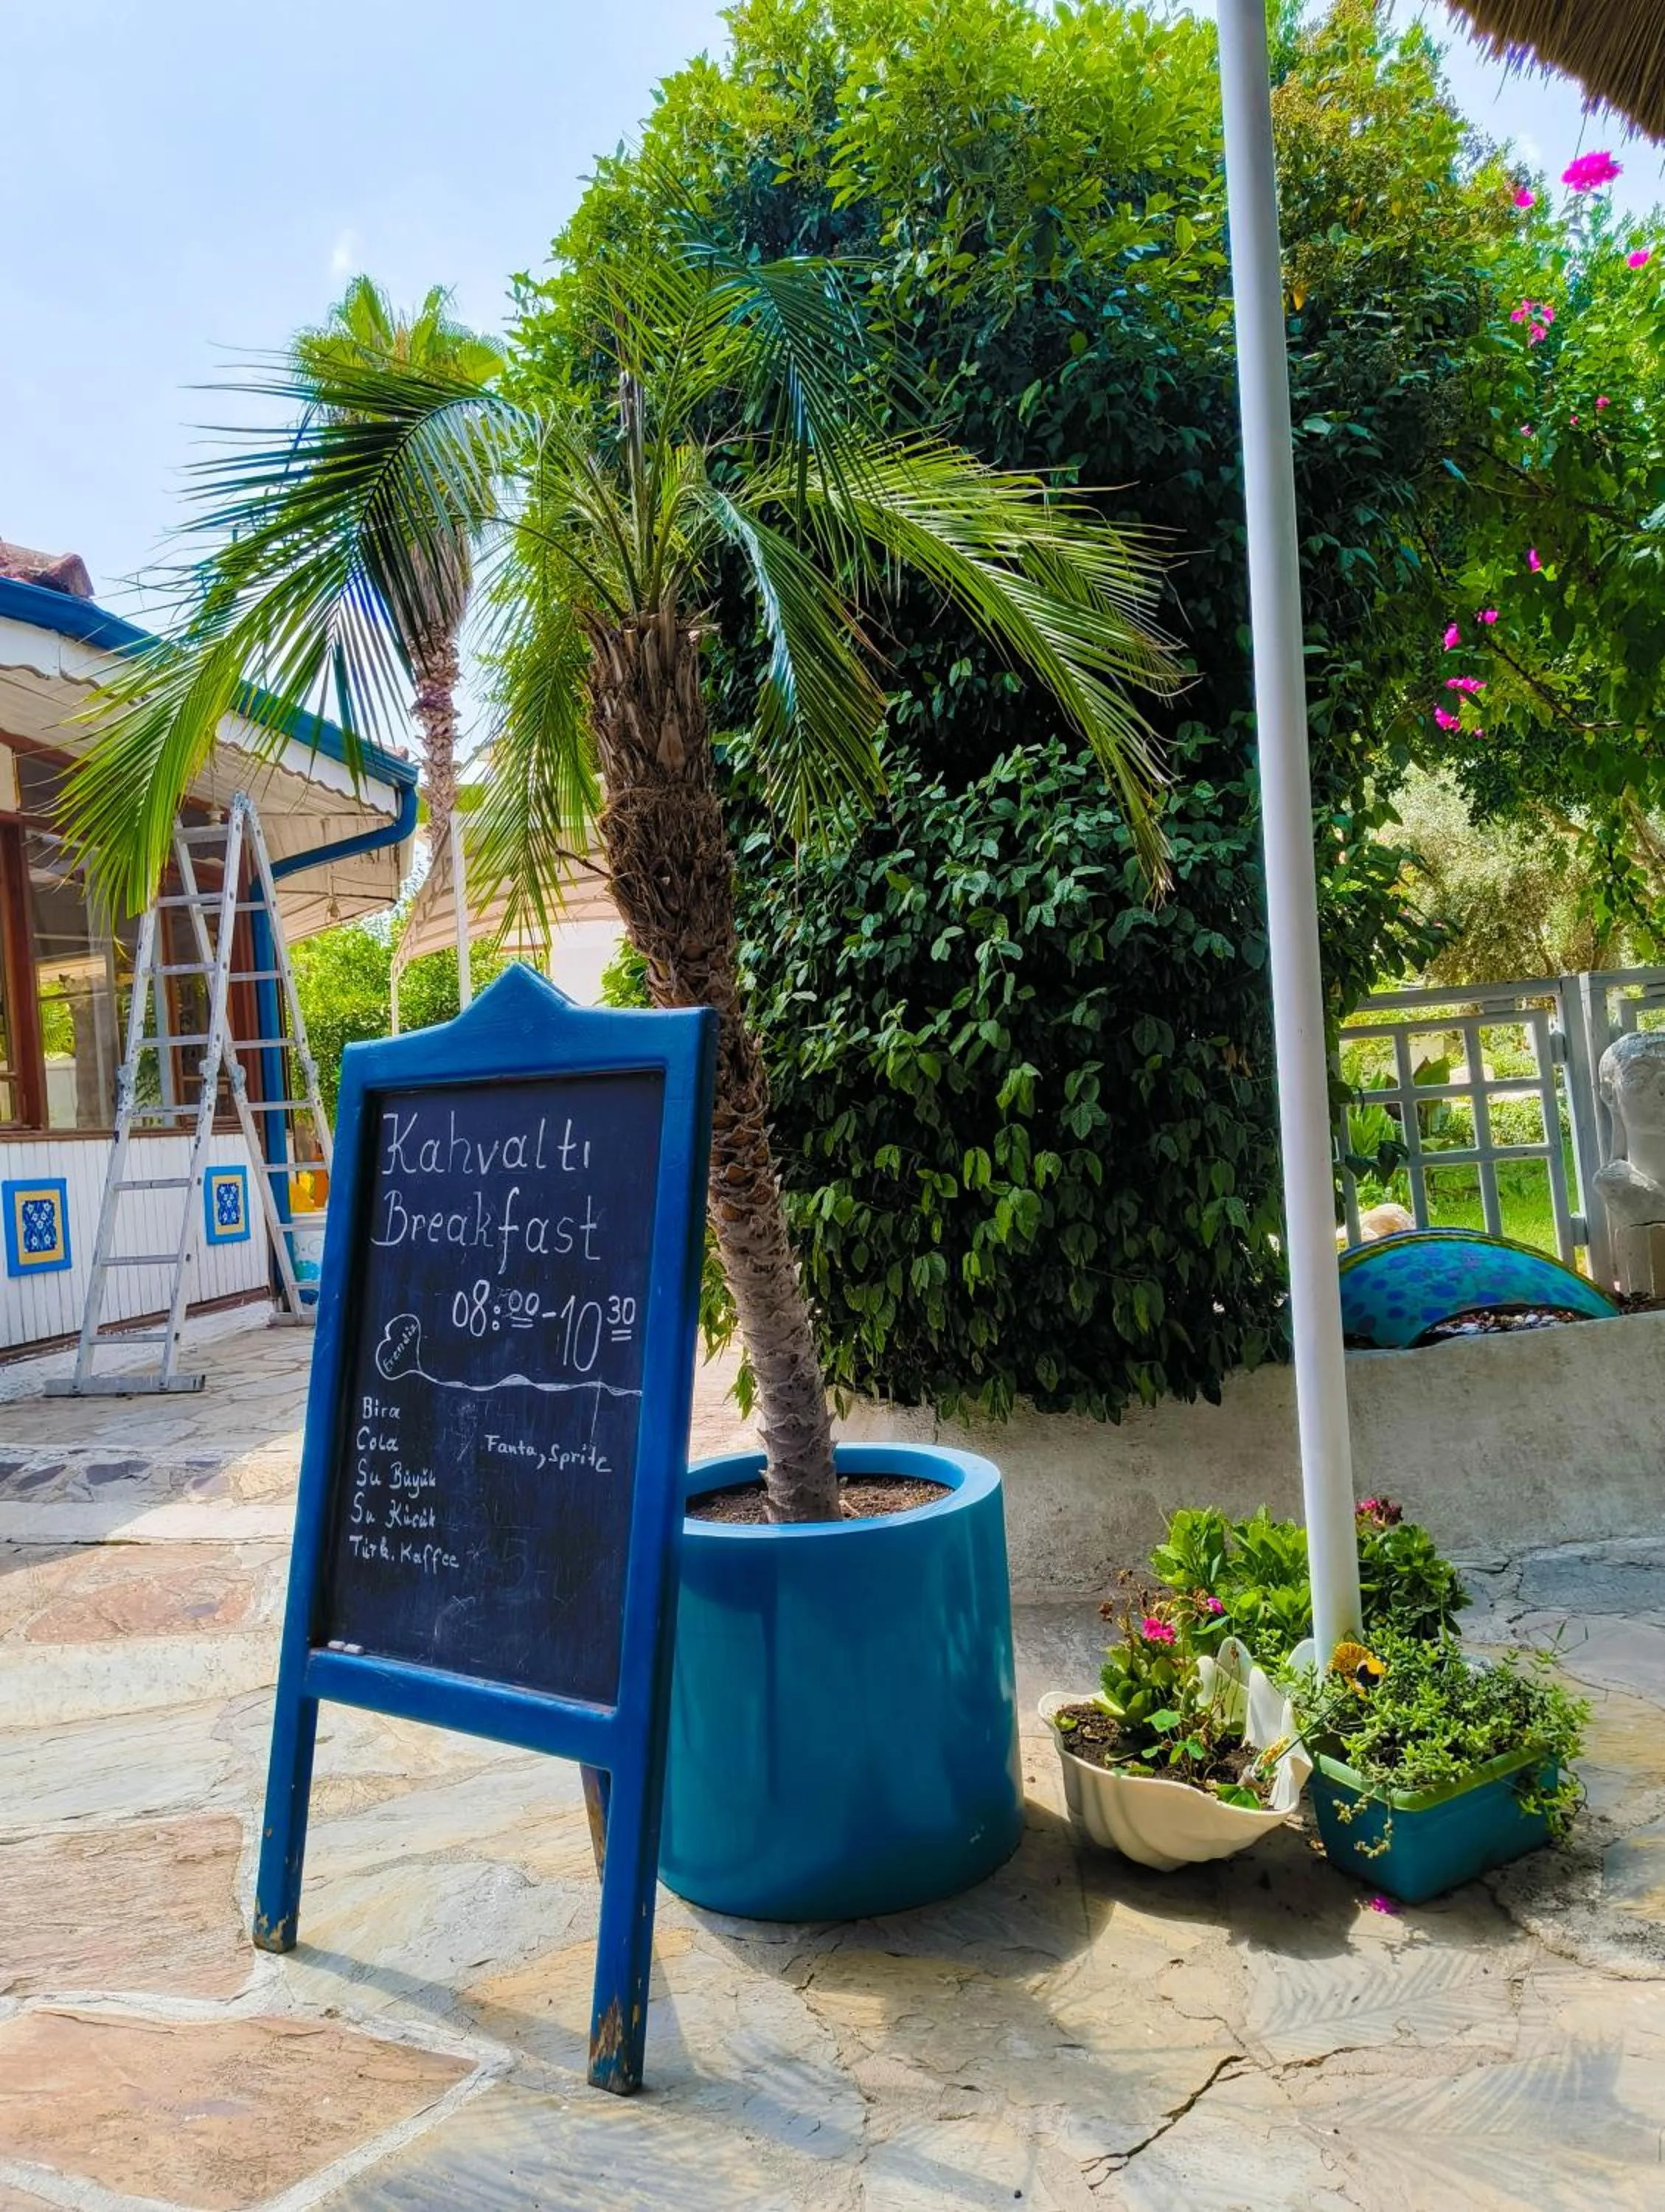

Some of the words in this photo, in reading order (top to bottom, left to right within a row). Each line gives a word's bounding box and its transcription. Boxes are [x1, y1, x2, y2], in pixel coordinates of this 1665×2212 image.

[371, 1187, 600, 1274] Breakfast
[363, 1397, 400, 1420] Bira
[357, 1427, 399, 1451] Cola
[356, 1458, 381, 1486] Su
[350, 1492, 376, 1523] Su
[400, 1542, 459, 1574] Kaffee
